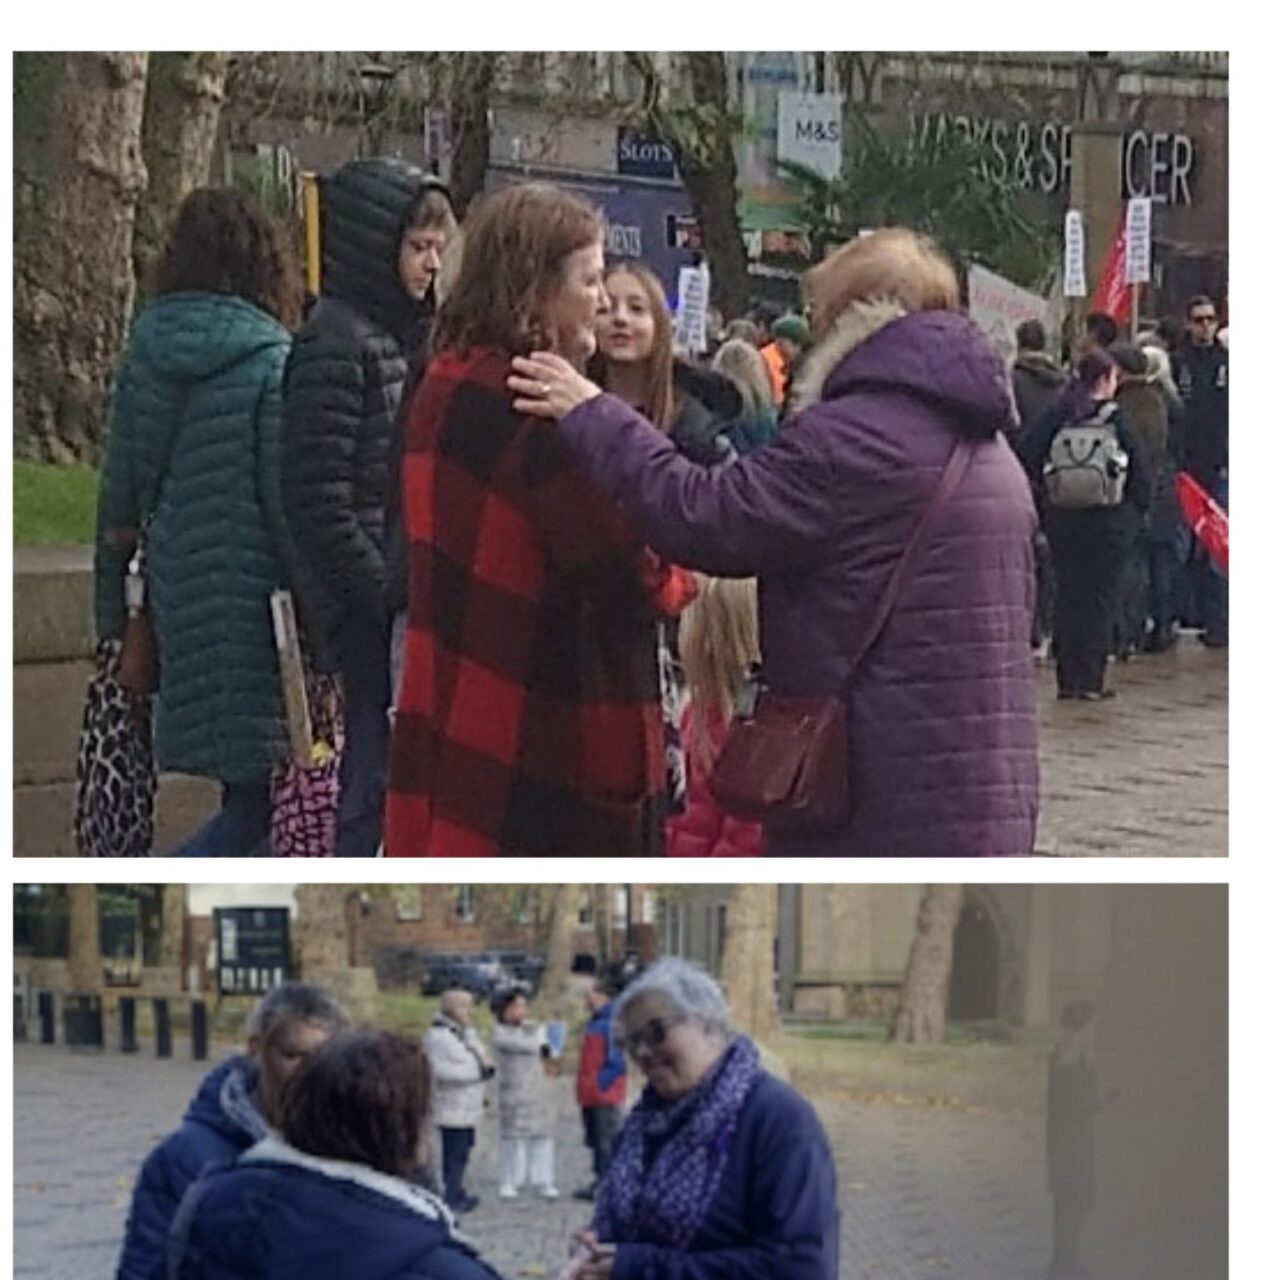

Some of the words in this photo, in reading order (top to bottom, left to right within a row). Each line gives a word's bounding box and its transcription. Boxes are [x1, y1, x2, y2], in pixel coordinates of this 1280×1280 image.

[794, 120, 839, 141] M&S
[1014, 121, 1035, 188] &
[1038, 123, 1193, 206] SPCER
